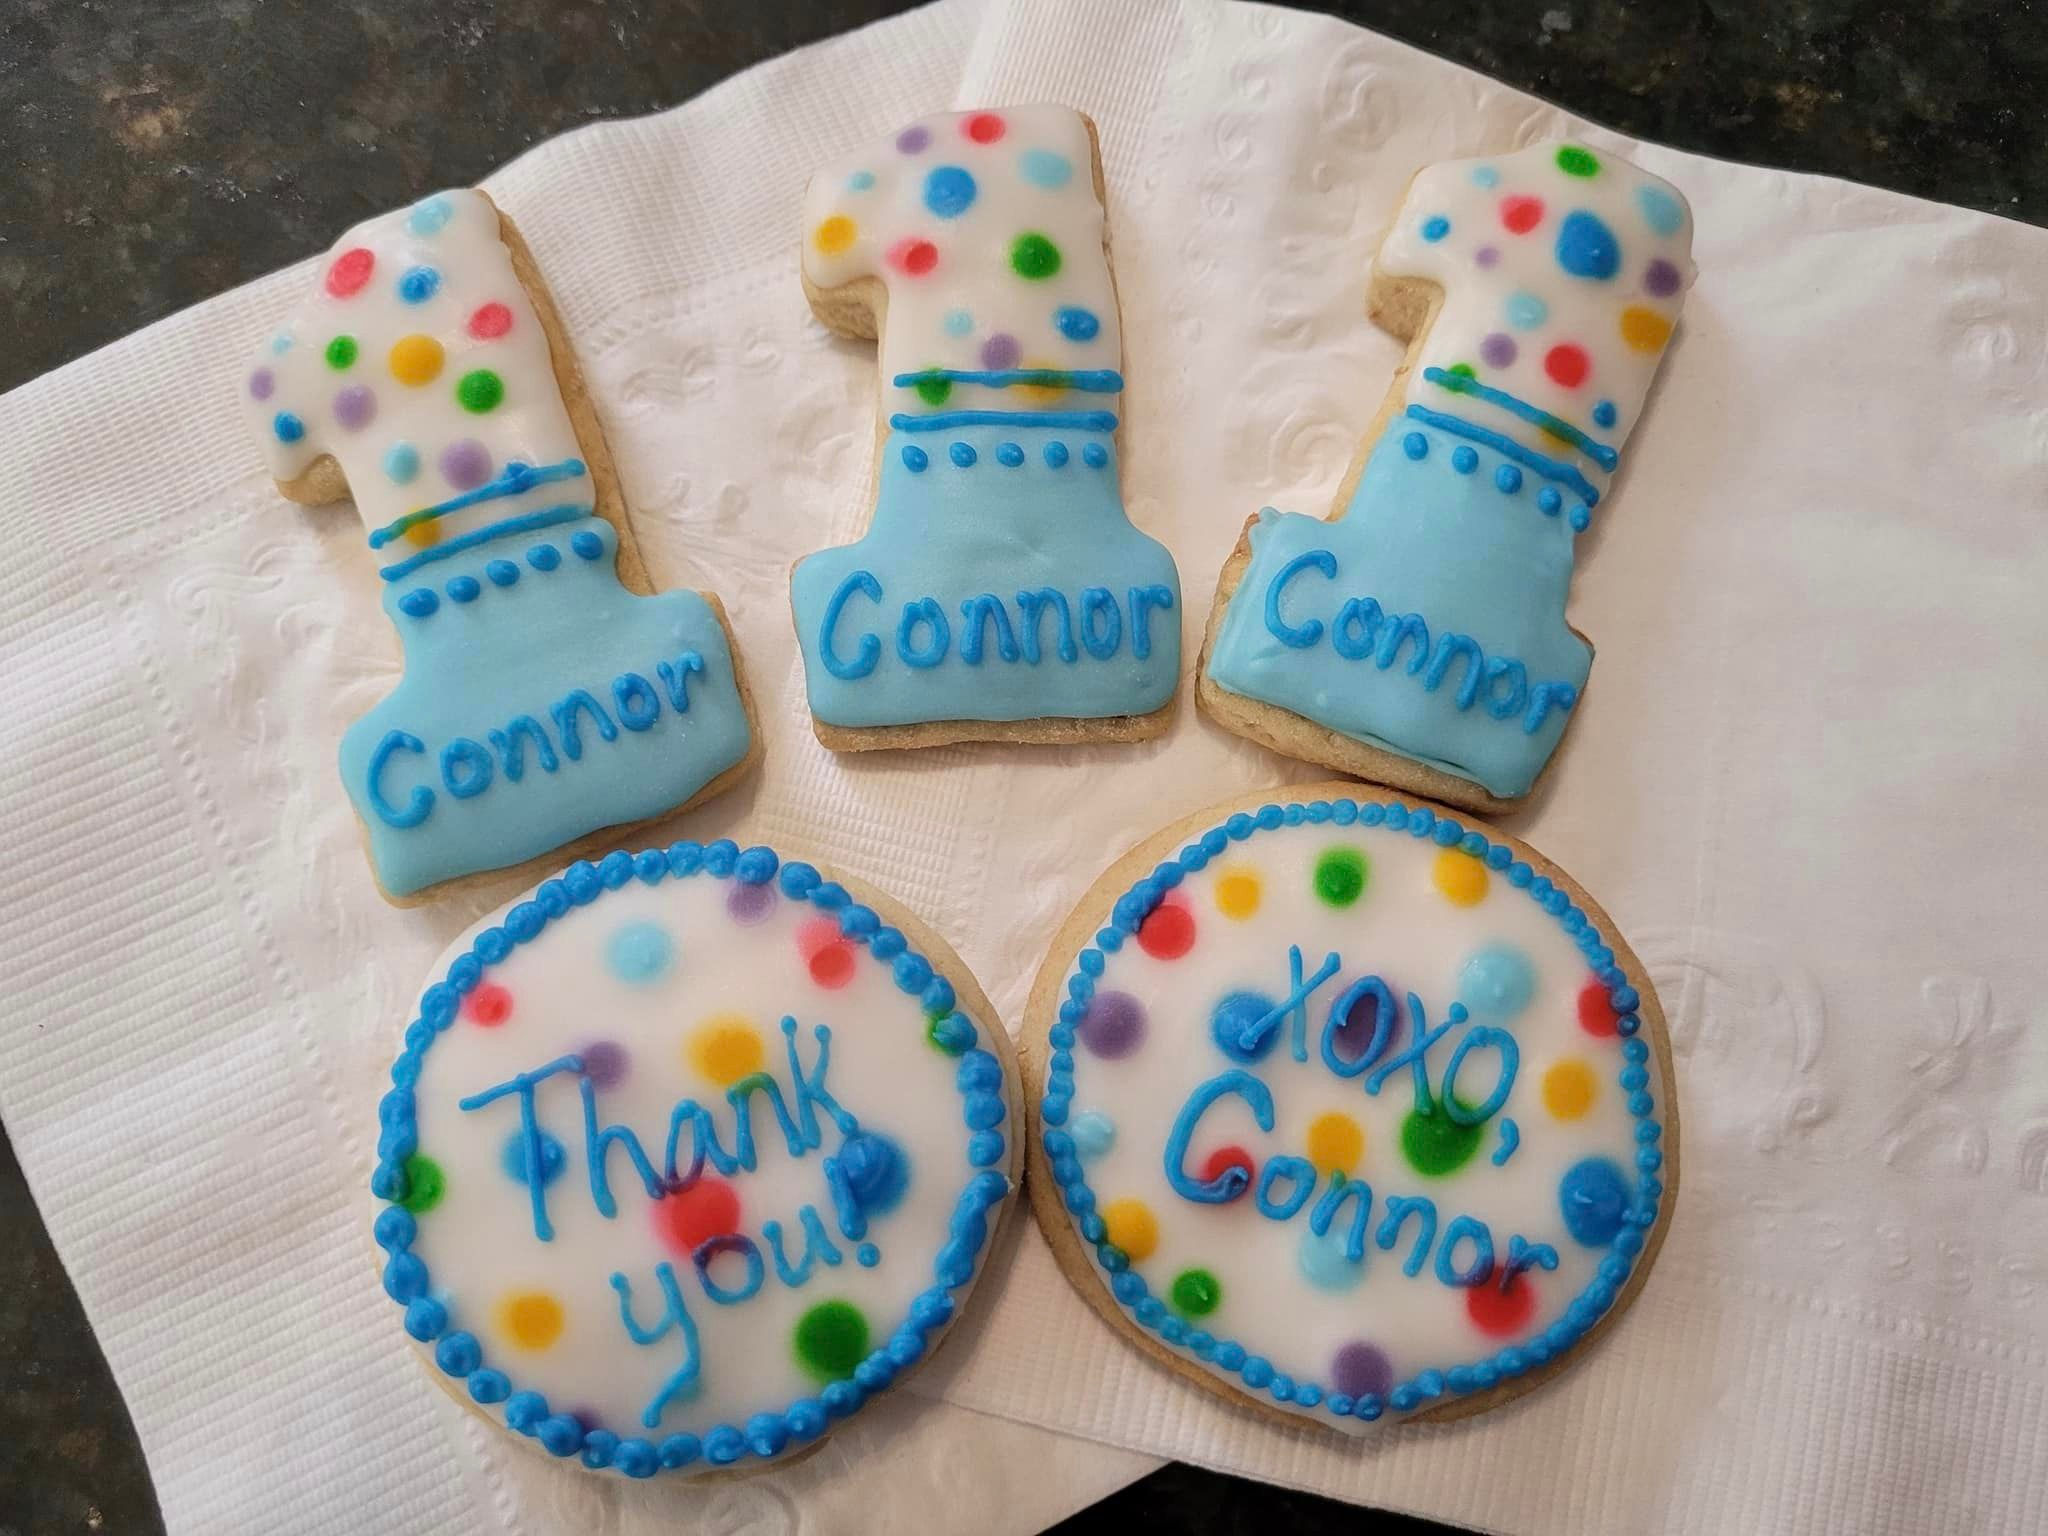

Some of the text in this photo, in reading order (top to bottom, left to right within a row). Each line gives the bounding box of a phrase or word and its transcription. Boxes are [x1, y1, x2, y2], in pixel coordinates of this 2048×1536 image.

[819, 570, 1174, 681] Connor
[1265, 550, 1577, 736] Connor
[367, 649, 705, 829] Connor
[458, 1015, 860, 1242] Thank
[1163, 1069, 1560, 1292] Connor
[609, 1156, 881, 1428] you!
